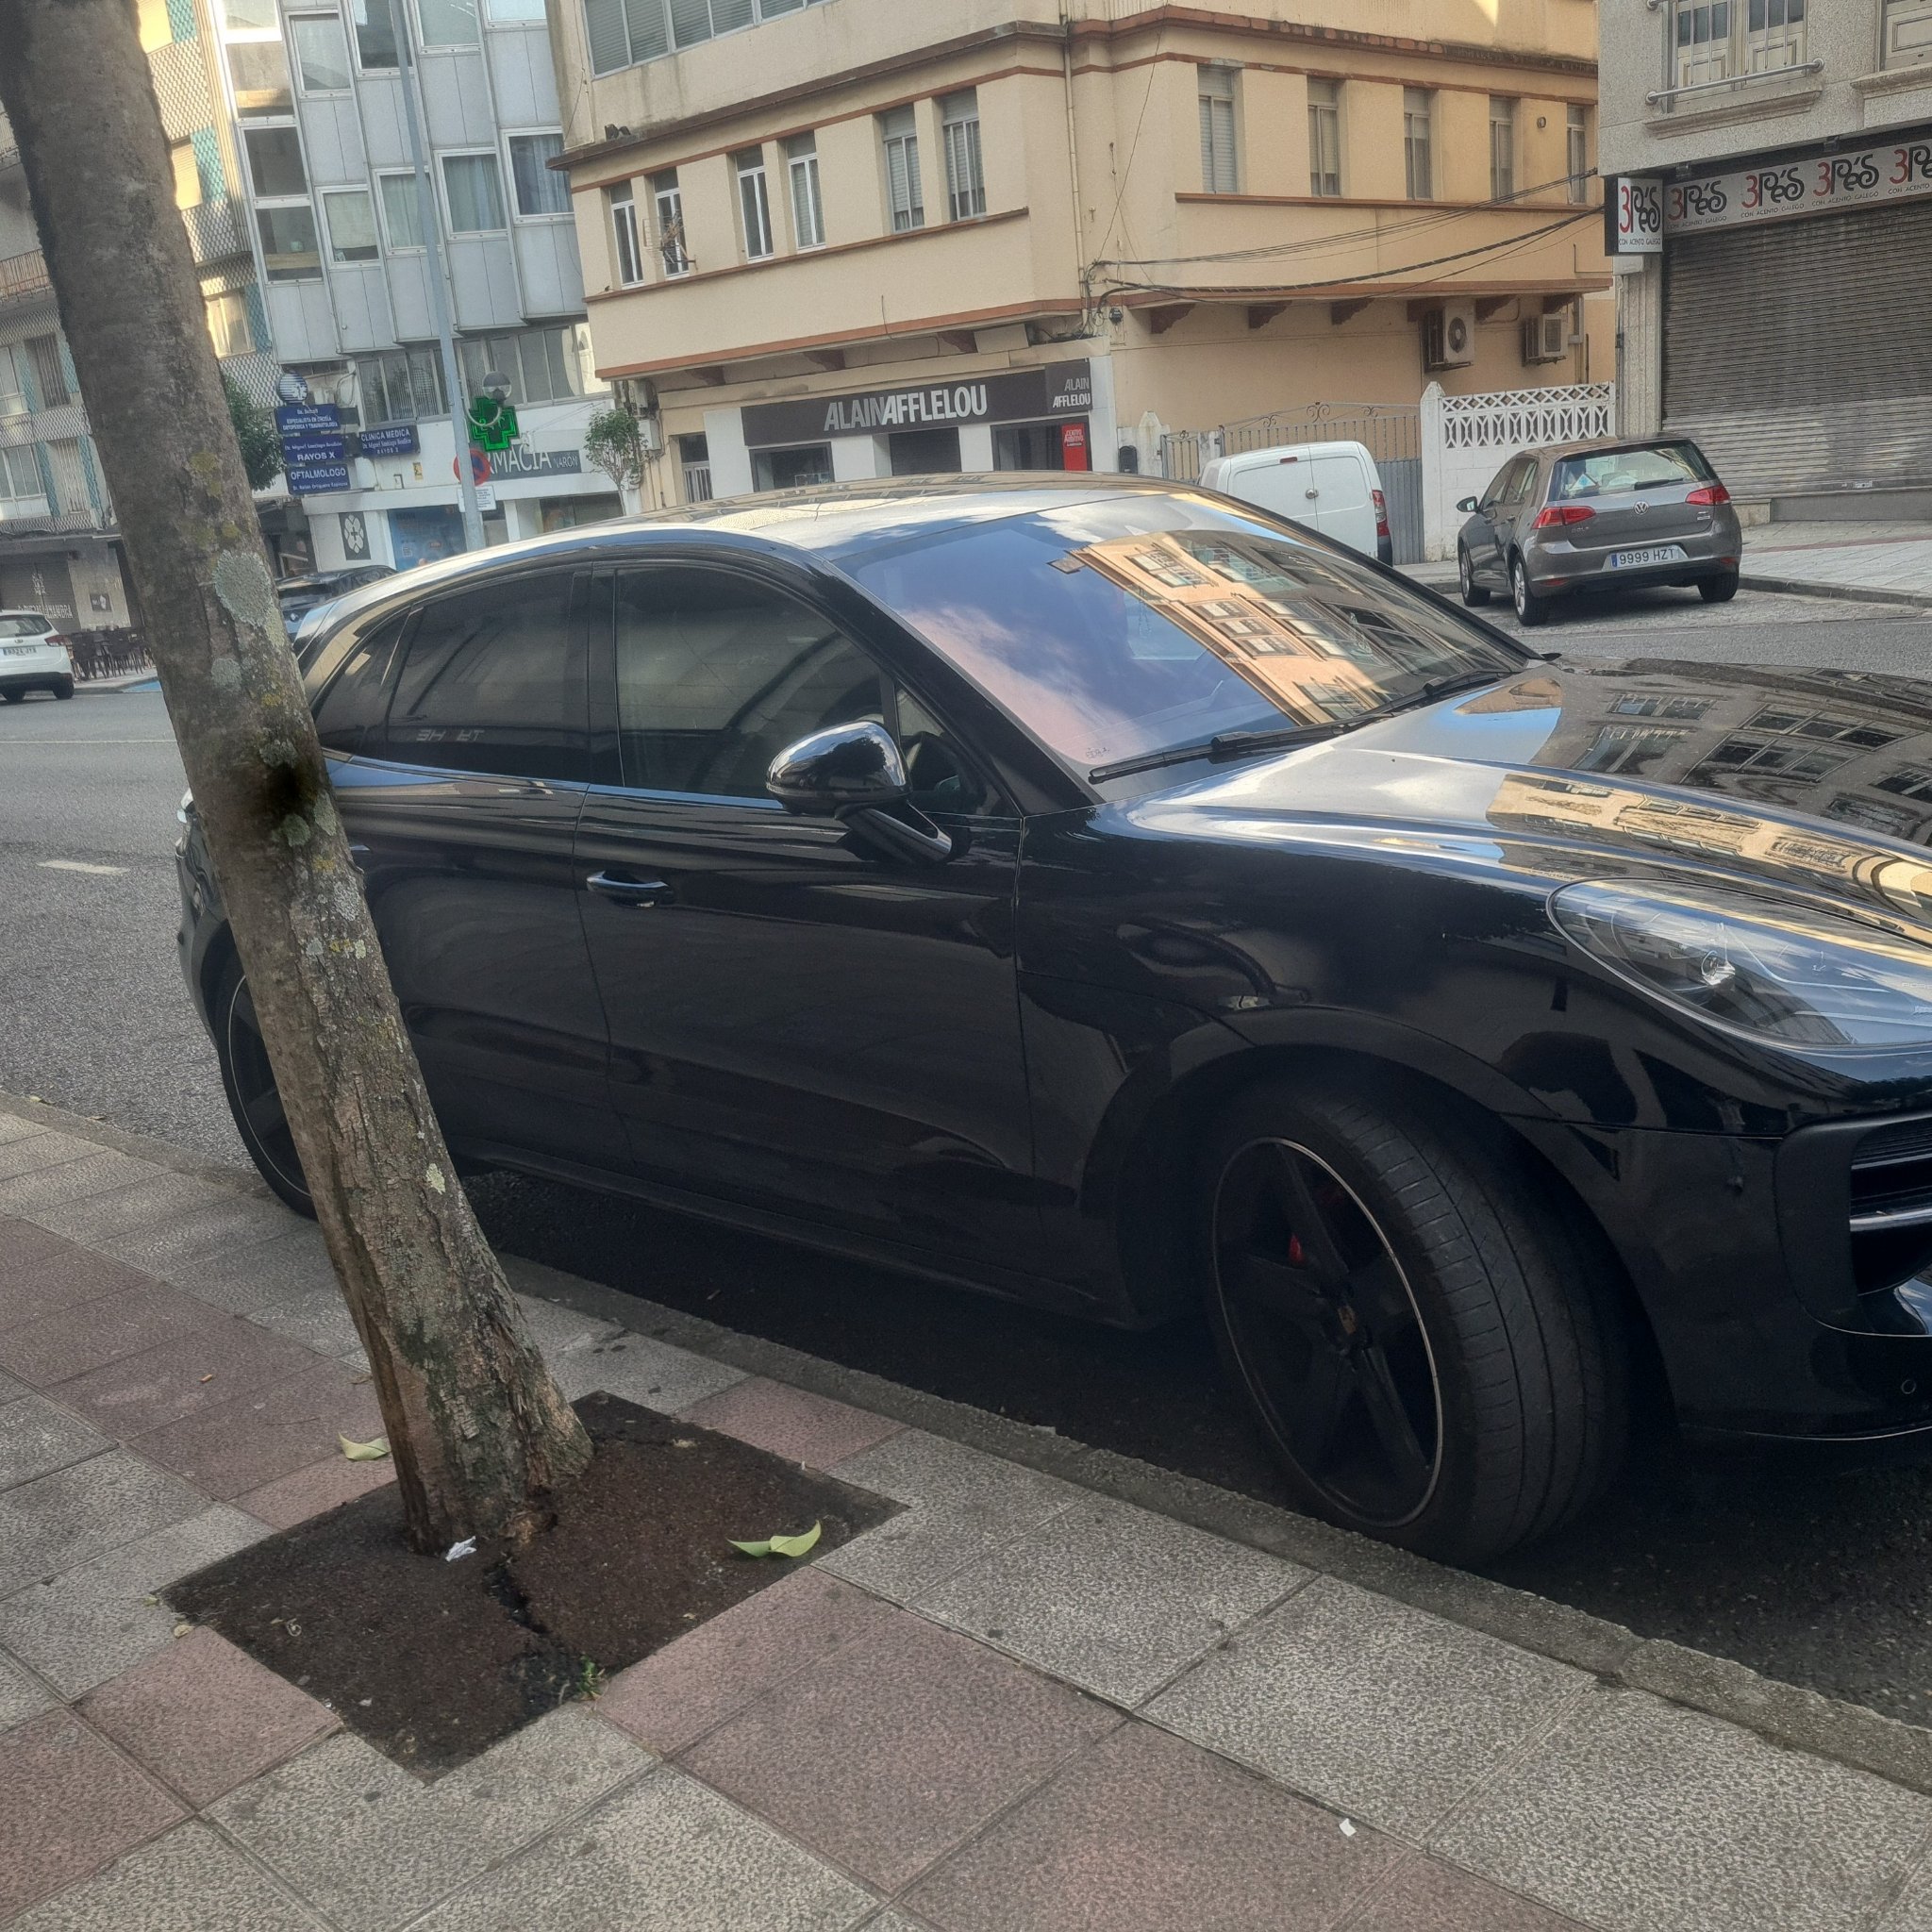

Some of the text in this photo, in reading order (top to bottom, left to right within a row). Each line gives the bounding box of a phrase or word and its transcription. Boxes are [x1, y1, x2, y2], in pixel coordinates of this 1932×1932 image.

[1906, 183, 1930, 192] ACENTO
[1827, 195, 1852, 204] ACENTO
[1854, 191, 1879, 200] GALEGO
[1757, 207, 1779, 215] ACENTO
[1781, 203, 1805, 211] GALEGO
[1064, 377, 1090, 391] ALAIN
[1052, 392, 1091, 408] AFFLELOU
[296, 452, 327, 461] RAYOS
[1619, 548, 1675, 564] 9999 HZT
